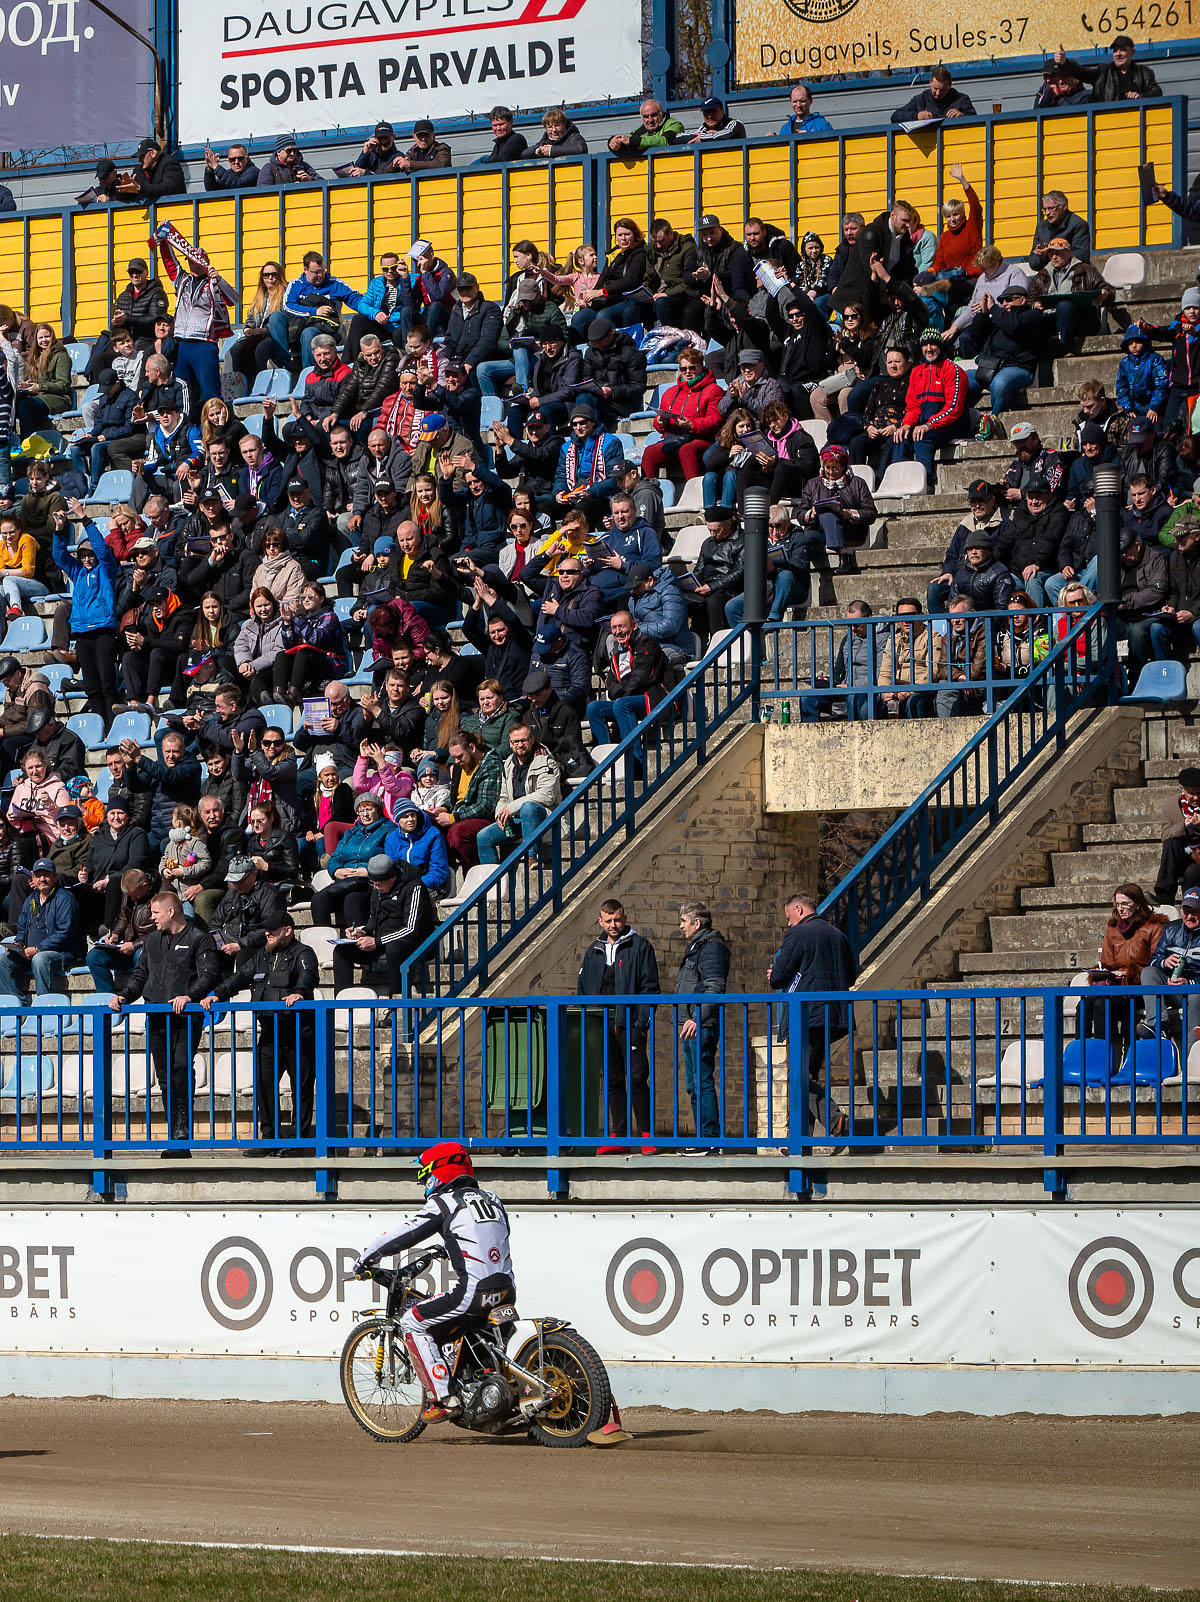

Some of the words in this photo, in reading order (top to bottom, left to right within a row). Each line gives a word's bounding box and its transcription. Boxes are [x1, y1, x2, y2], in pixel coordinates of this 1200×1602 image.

[223, 0, 514, 42] DAUGAVPILS
[760, 30, 900, 69] Daugavpils,
[908, 17, 1030, 54] Saules-37
[220, 61, 367, 111] SPORTA
[378, 36, 577, 94] PĀRVALDE
[468, 1199, 498, 1220] 10
[701, 1248, 921, 1309] OPTIBET
[10, 1301, 76, 1319] BĀRS
[290, 1309, 361, 1323] SPOR
[701, 1313, 830, 1329] SPORTA
[843, 1309, 921, 1329] BĀRS
